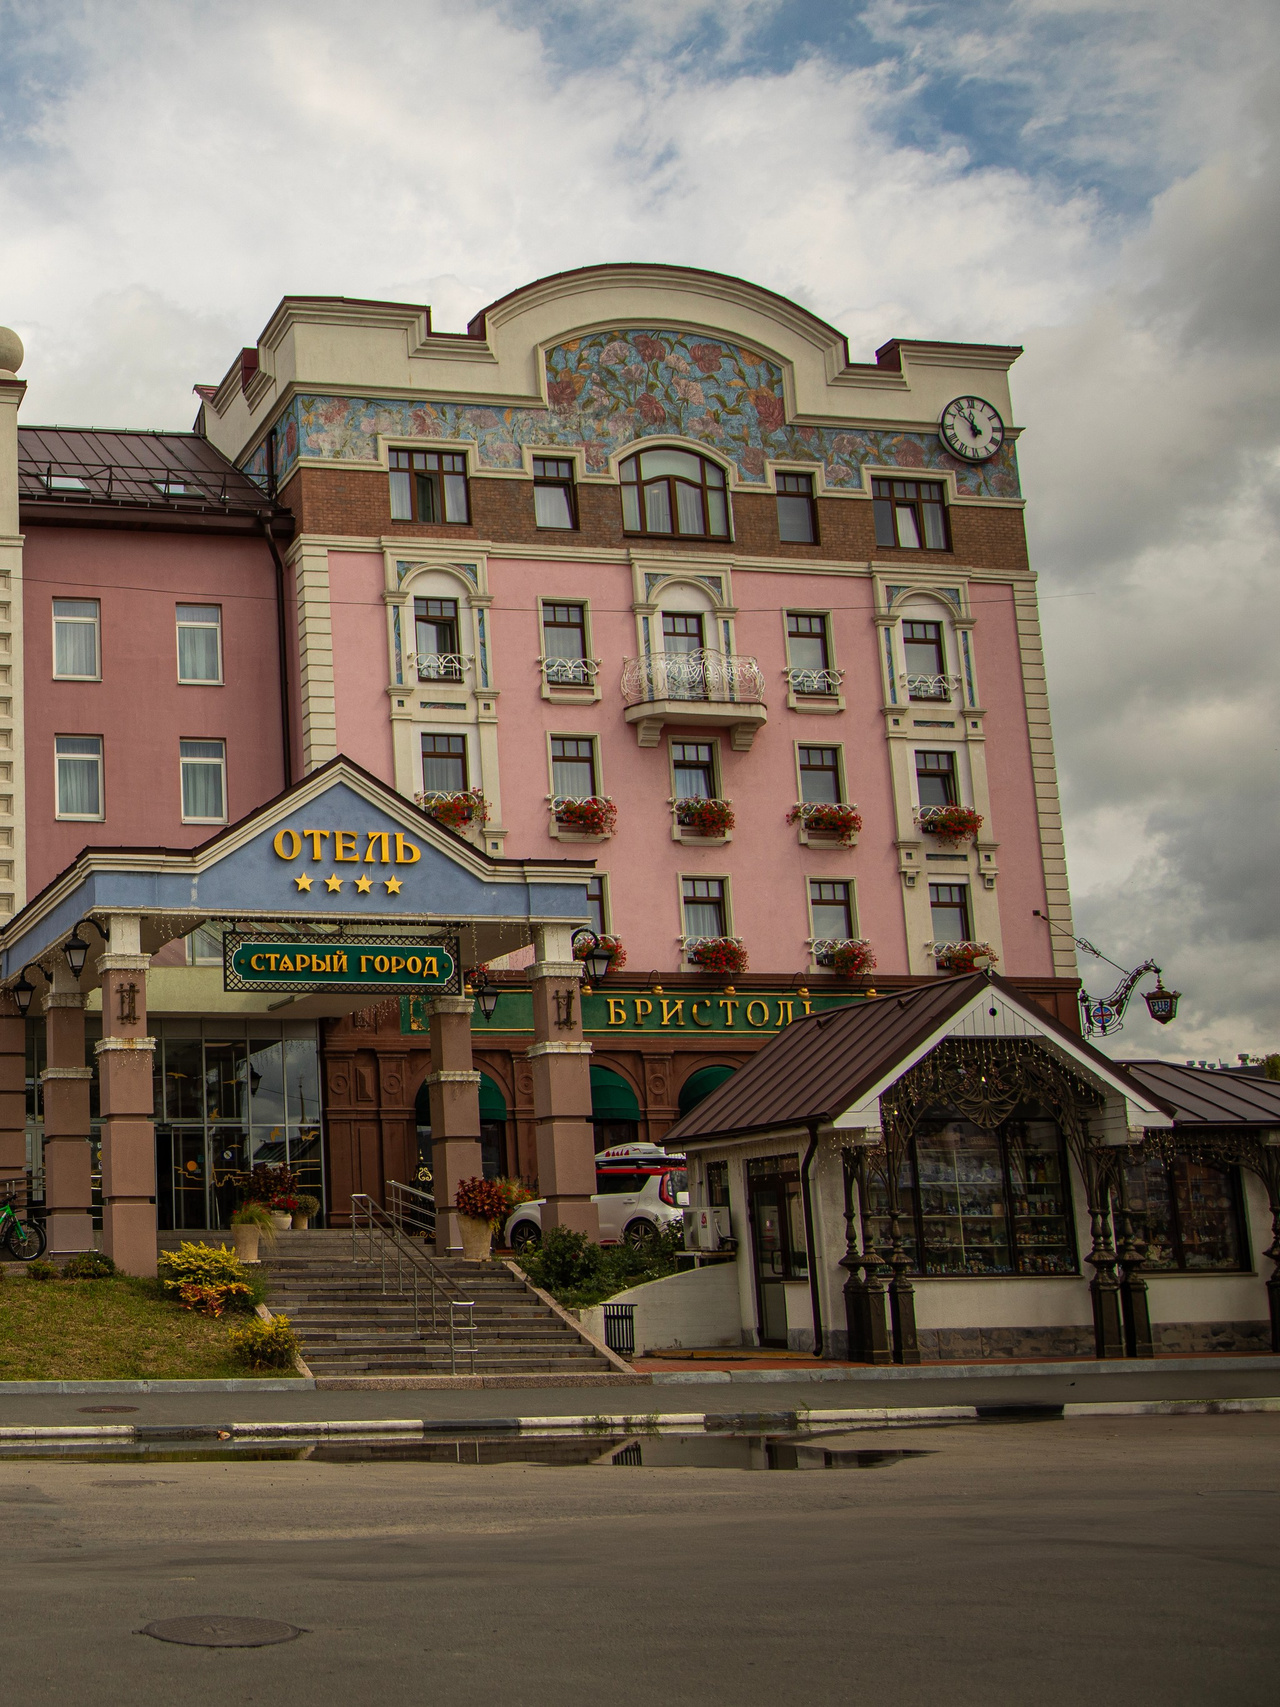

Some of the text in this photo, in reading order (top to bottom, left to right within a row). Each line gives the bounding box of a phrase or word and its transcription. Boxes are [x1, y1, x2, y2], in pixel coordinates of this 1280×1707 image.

[273, 829, 422, 864] ОТЕЛЬ
[250, 950, 440, 978] СТАРЫЙ ГОРОД
[1151, 1000, 1169, 1010] PUB
